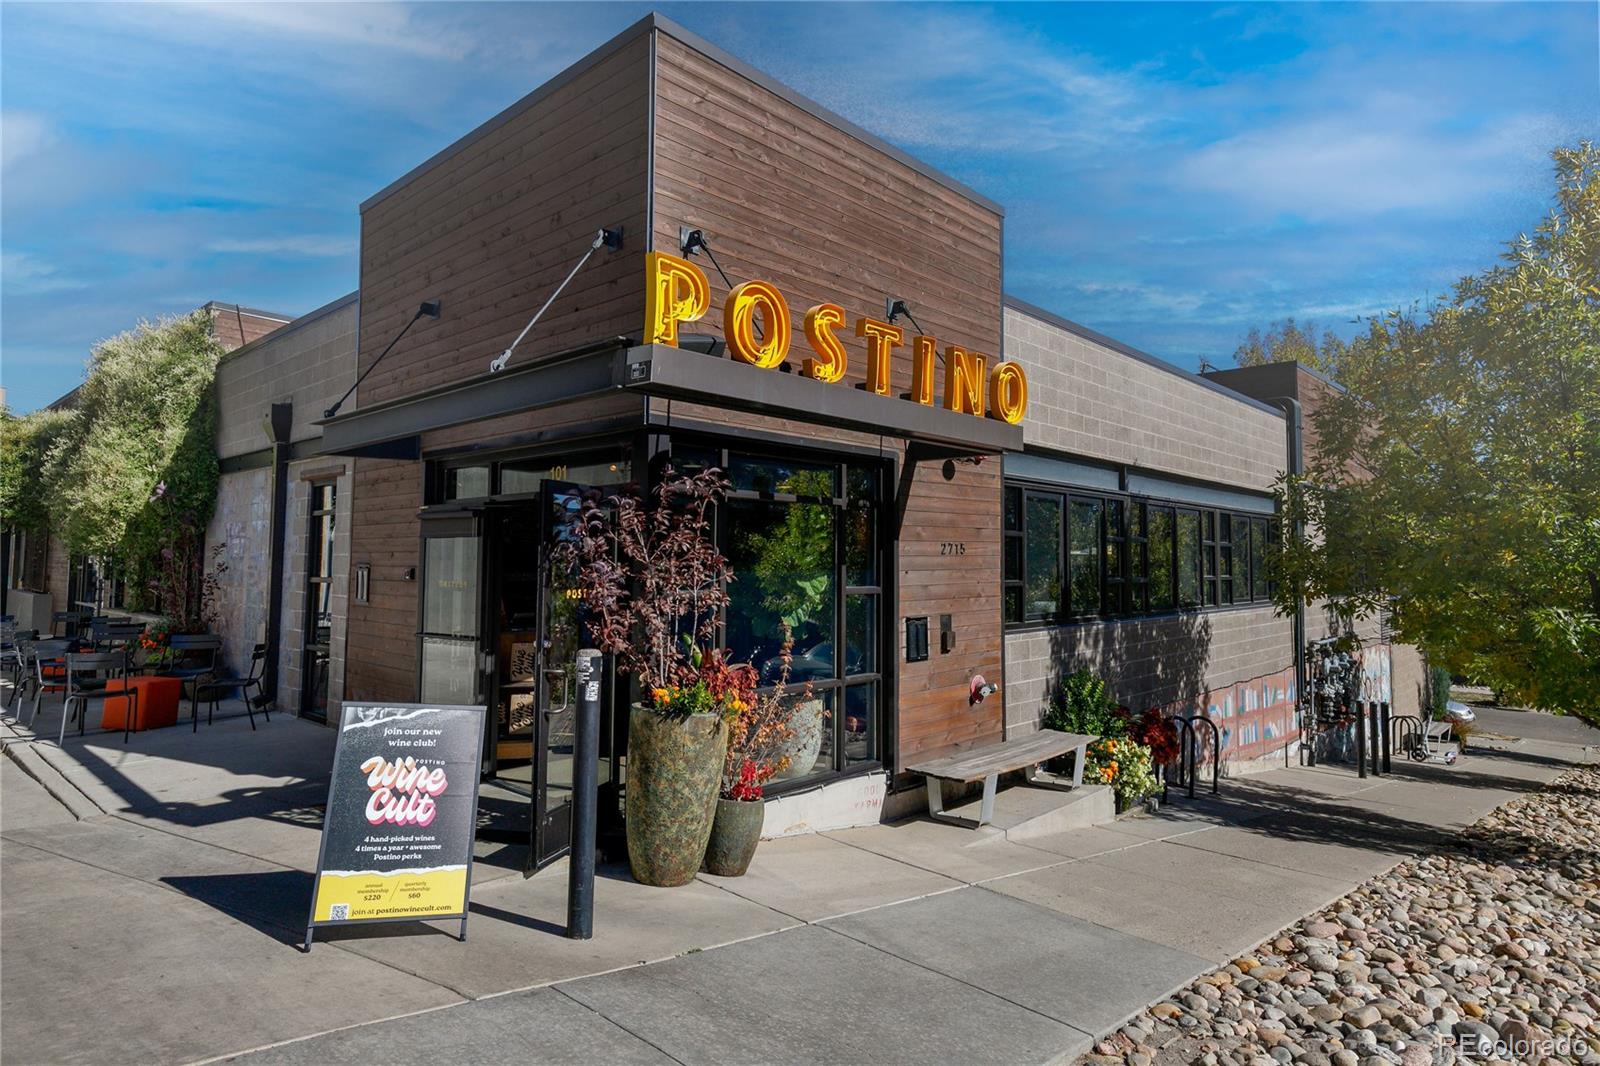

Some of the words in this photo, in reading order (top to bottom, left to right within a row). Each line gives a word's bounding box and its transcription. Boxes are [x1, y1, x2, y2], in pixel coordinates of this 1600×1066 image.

[642, 250, 1029, 425] POSTINO
[550, 465, 567, 480] 101
[940, 543, 966, 556] 2715
[566, 588, 588, 599] POST
[383, 727, 403, 737] join
[405, 728, 421, 736] our
[422, 728, 443, 736] new
[388, 739, 412, 747] wine
[413, 738, 437, 747] club!
[416, 758, 446, 766] POSTINO
[360, 756, 448, 797] Wine
[365, 786, 437, 827] Cult
[370, 835, 414, 844] hand-picked
[373, 853, 401, 861] Postino
[401, 853, 422, 861] perks
[364, 893, 382, 902] $220
[408, 892, 421, 900] $60
[351, 906, 367, 917] join
[367, 907, 375, 915] at
[376, 904, 452, 915] postinowinecult.com
